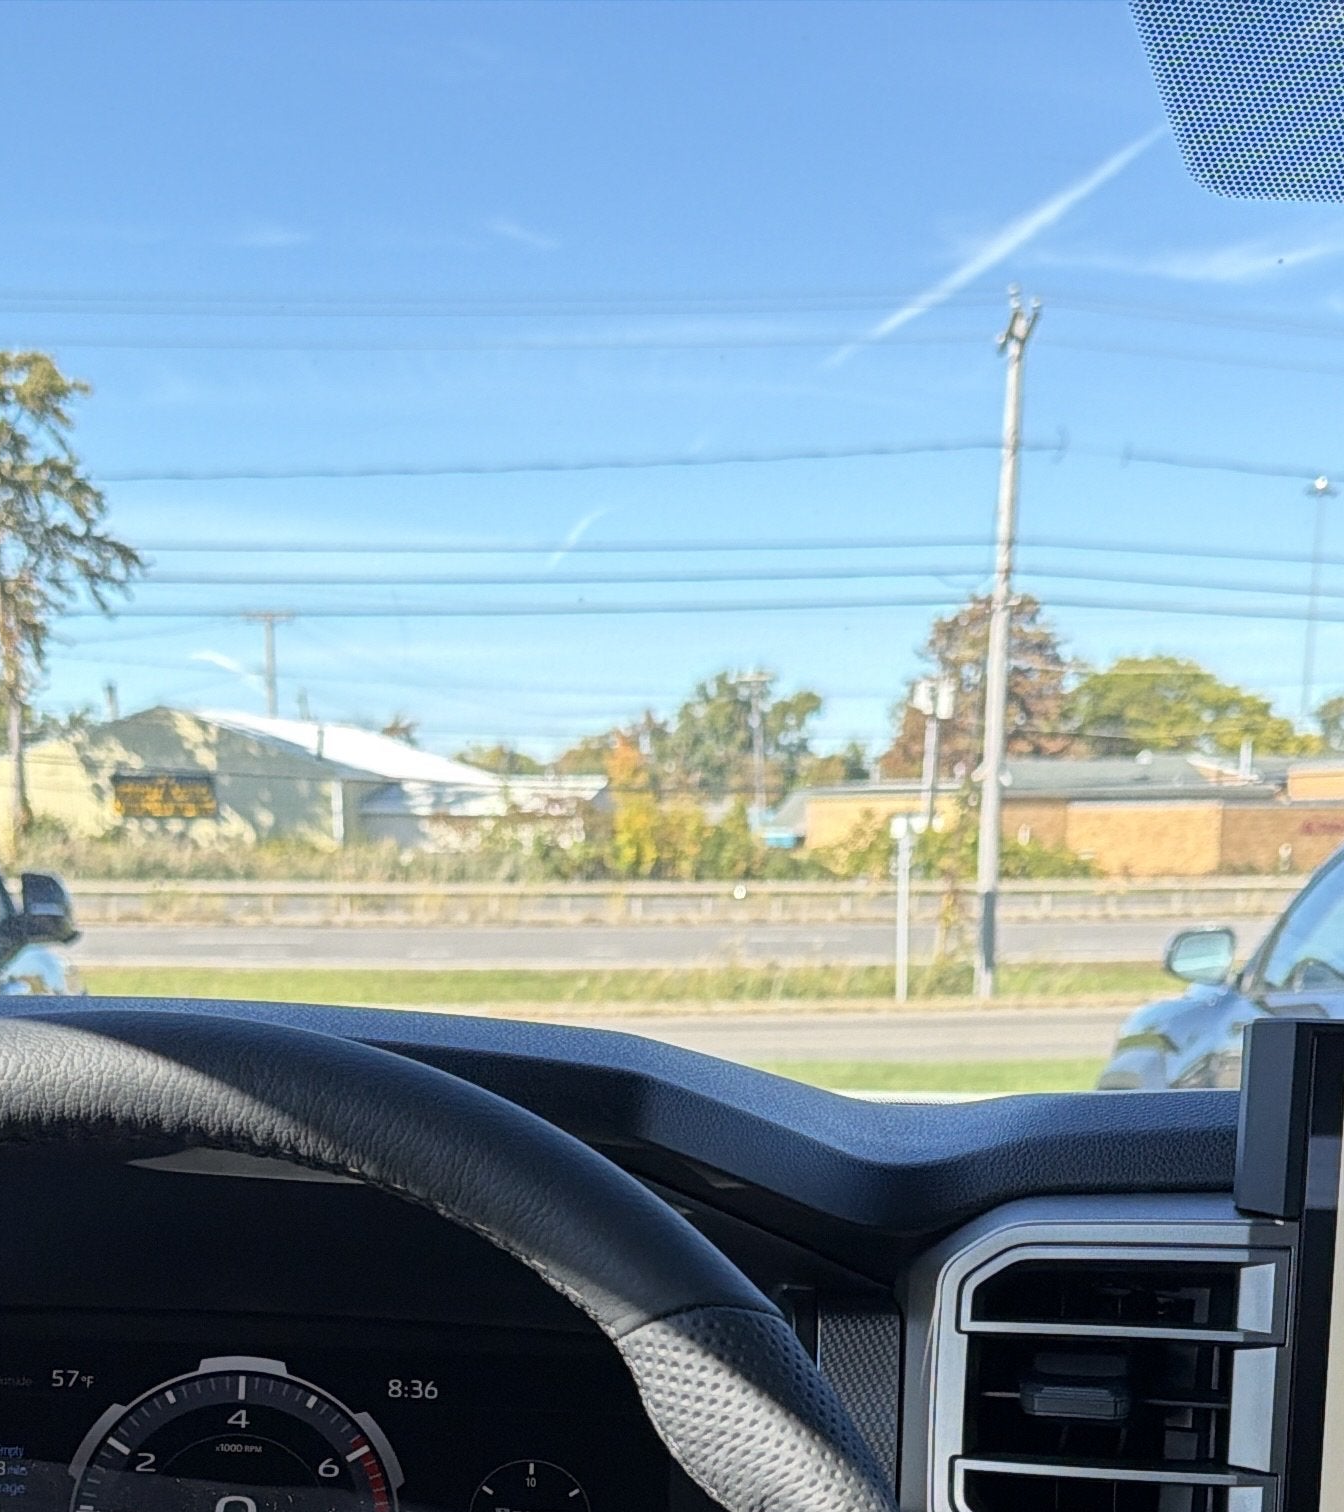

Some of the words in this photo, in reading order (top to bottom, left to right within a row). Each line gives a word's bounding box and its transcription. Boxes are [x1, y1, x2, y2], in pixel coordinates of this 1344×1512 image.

[387, 1379, 439, 1400] 8:36
[226, 1409, 251, 1429] 4
[135, 1452, 157, 1473] 2
[317, 1457, 340, 1479] 6
[525, 1477, 538, 1489] 10
